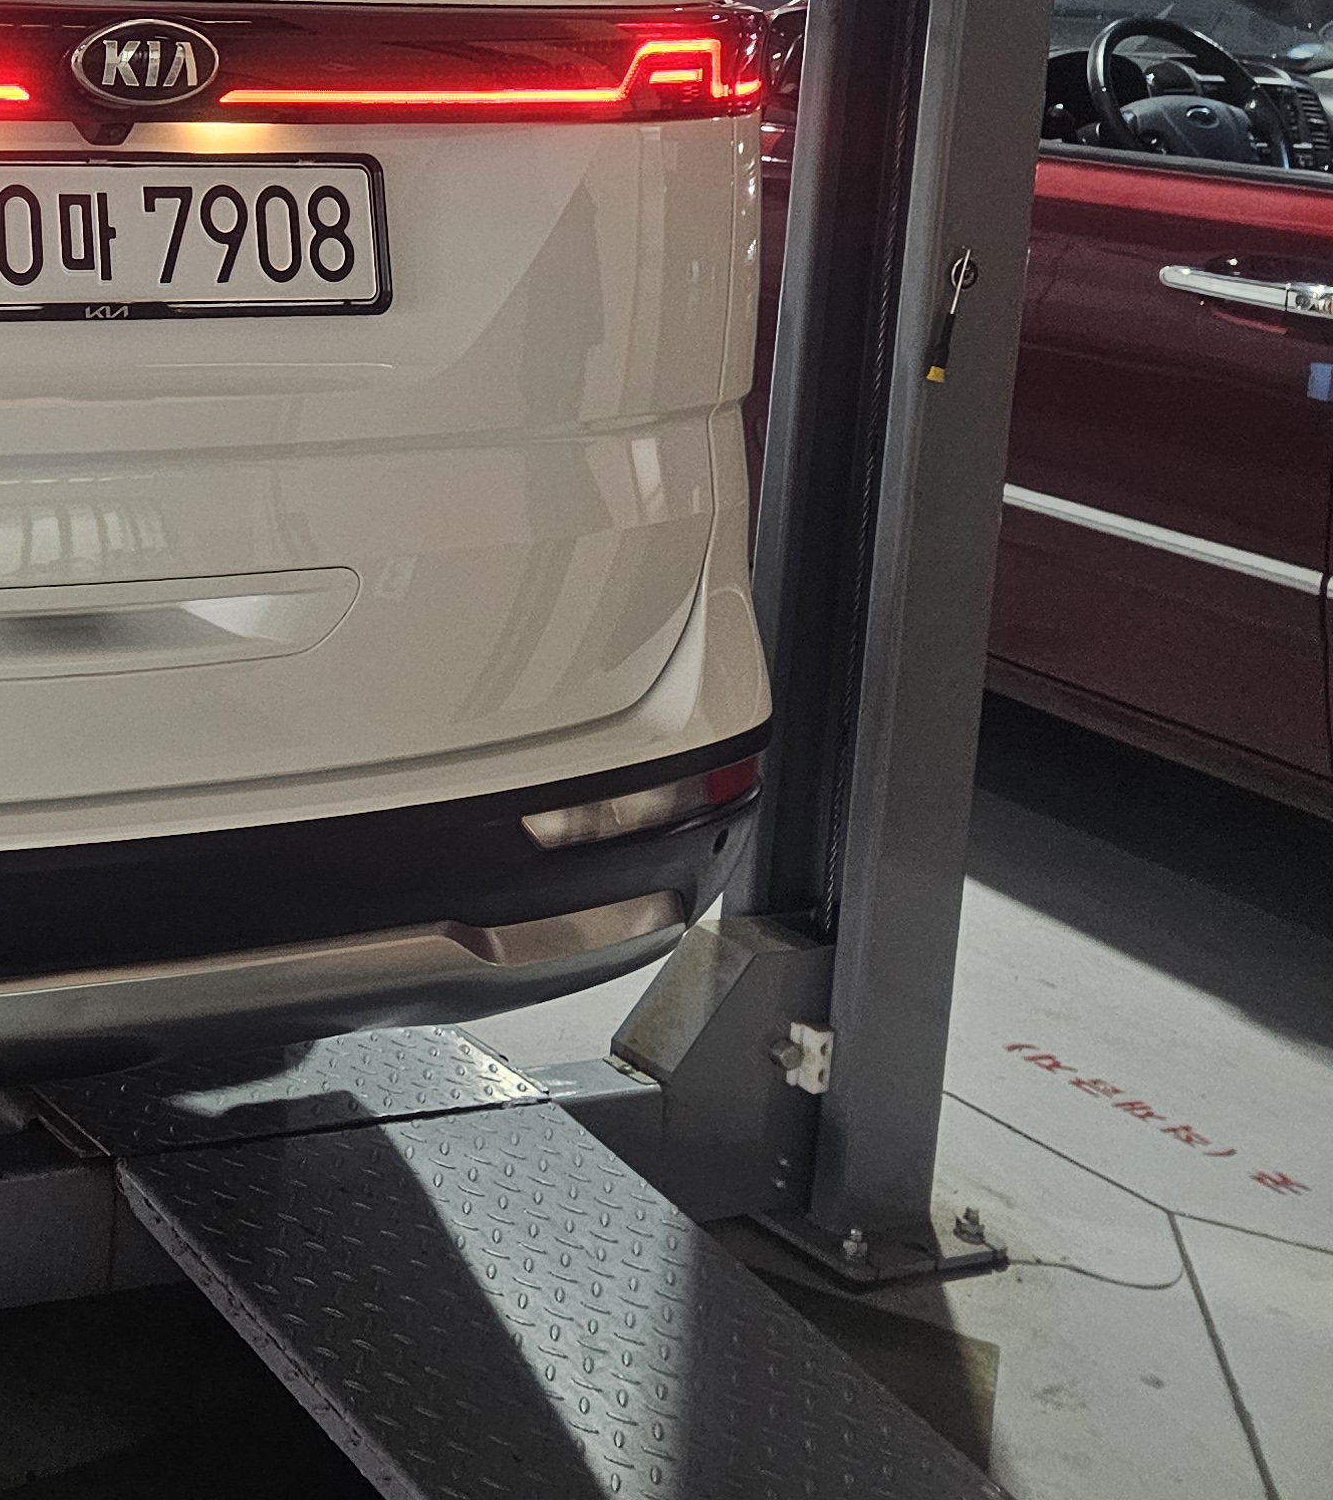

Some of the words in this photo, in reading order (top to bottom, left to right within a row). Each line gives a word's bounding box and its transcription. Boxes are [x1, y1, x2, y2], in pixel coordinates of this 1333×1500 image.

[101, 40, 198, 87] KIA
[142, 185, 355, 284] 7908
[85, 305, 129, 319] KIA
